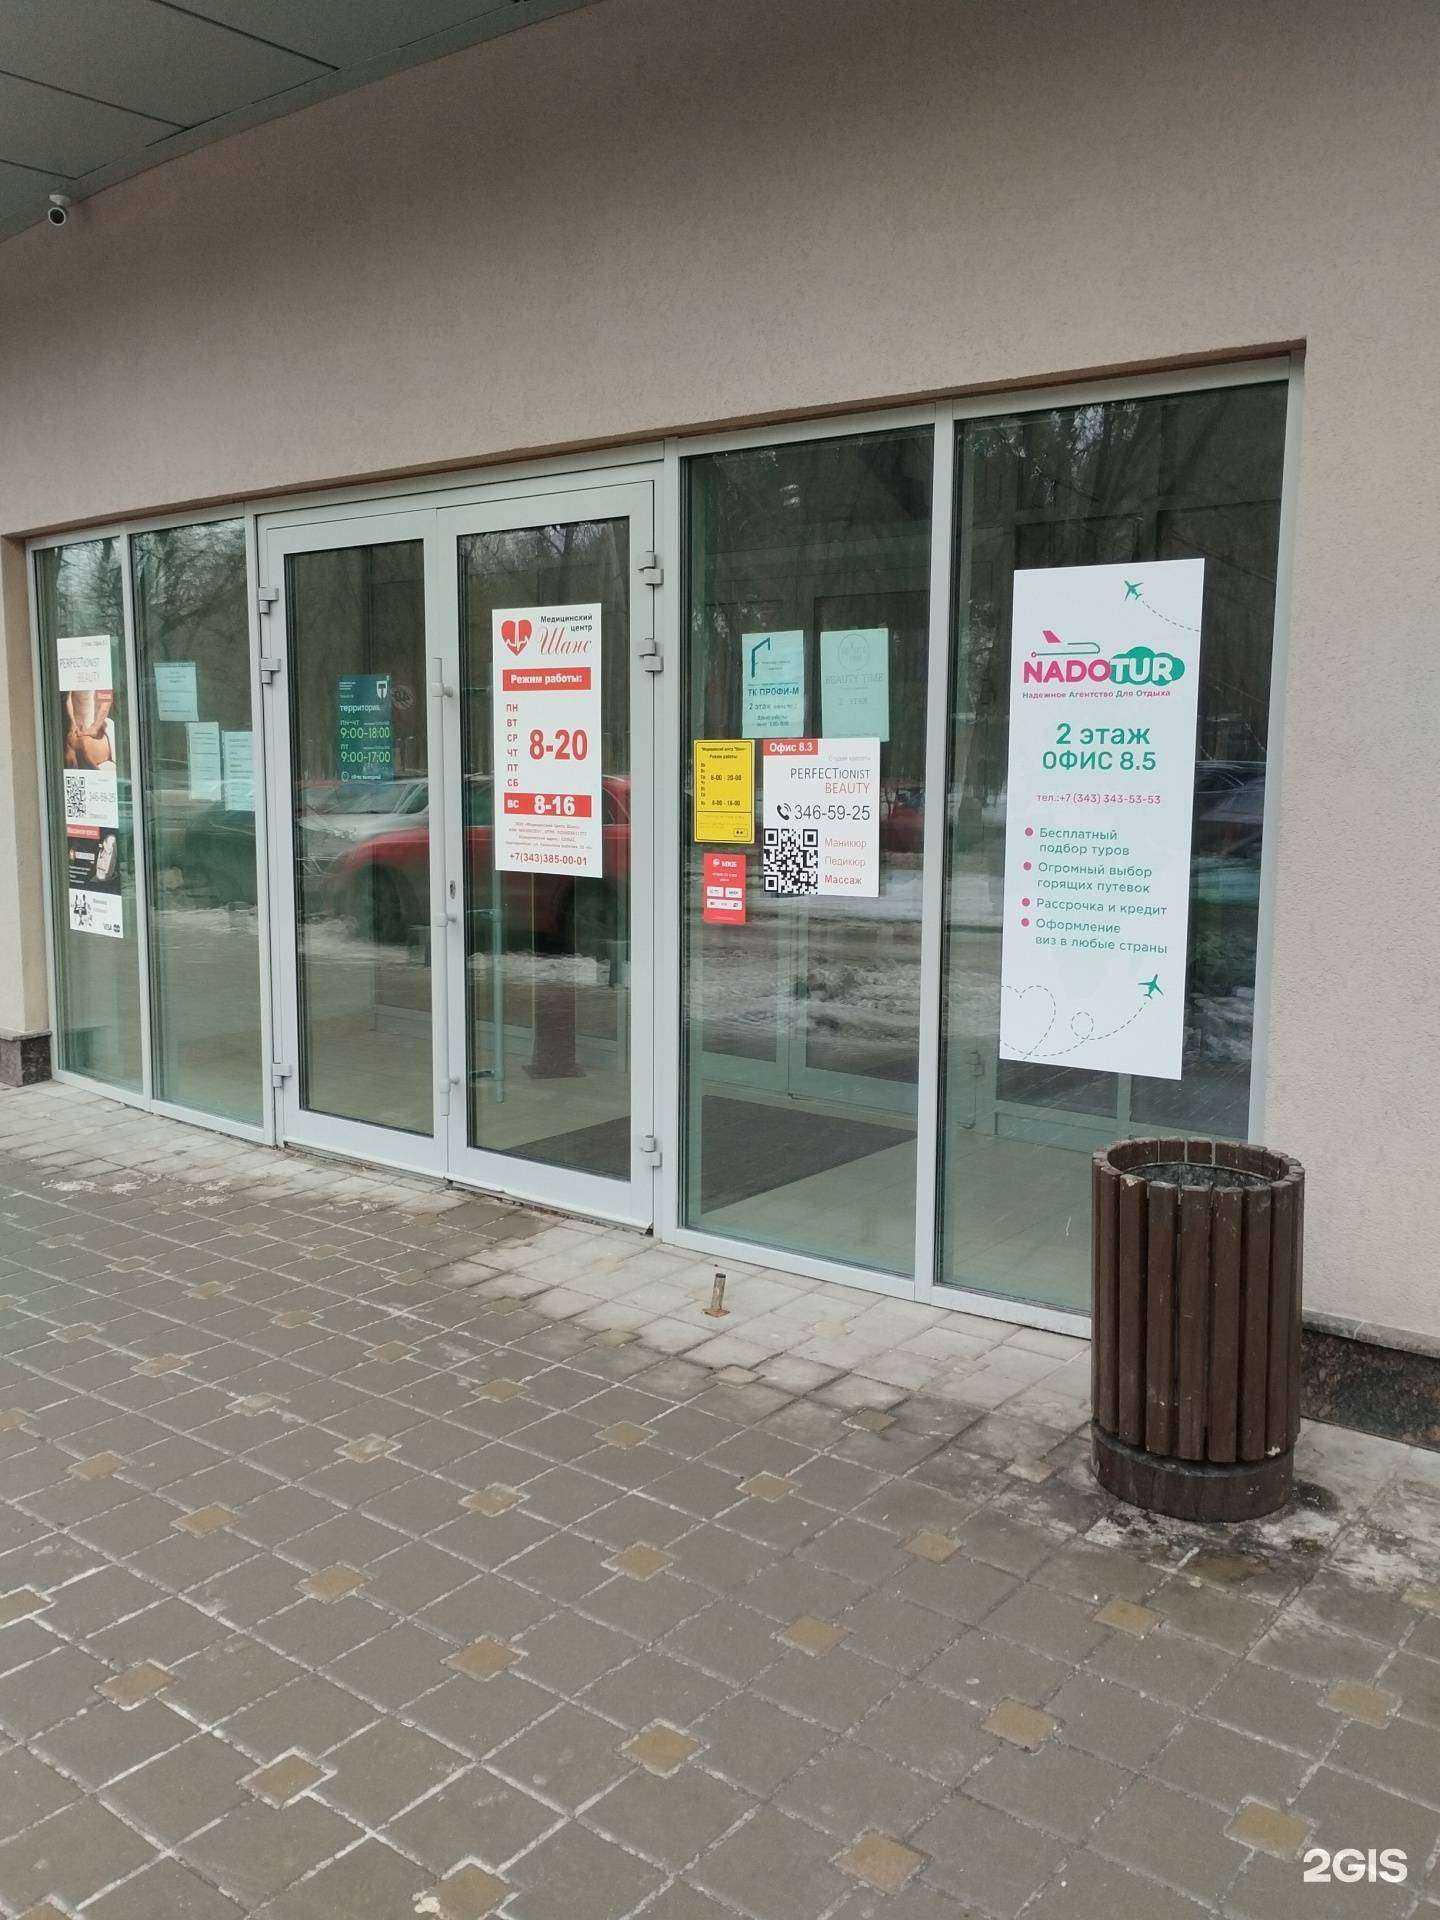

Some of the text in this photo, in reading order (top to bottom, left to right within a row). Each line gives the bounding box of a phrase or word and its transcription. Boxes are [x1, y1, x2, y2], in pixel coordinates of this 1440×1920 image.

[540, 614, 593, 624] Медицинский
[538, 627, 592, 656] Шанс
[1023, 657, 1173, 684] NADOTUR
[510, 674, 583, 686] Режим работы:
[759, 686, 800, 696] ПРОФИ-М
[1022, 689, 1171, 700] Надежное Агентство Для Отдыха
[506, 703, 519, 712] ПН
[506, 718, 518, 727] ВТ
[506, 733, 518, 742] СР
[1055, 722, 1151, 746] 2 этаж
[529, 729, 588, 760] 8-20
[769, 742, 813, 755] Офис 8.3
[506, 749, 519, 757] ЧТ
[1042, 749, 1157, 772] ОФИС 8.5
[506, 763, 519, 772] ПТ
[506, 778, 519, 787] СБ
[825, 782, 871, 794] BEAUTY
[506, 794, 576, 816] ВС 8-16
[1103, 793, 1162, 806] 343-53-53
[794, 804, 871, 821] 346-59-25
[1039, 827, 1118, 841] Бесплатный
[824, 837, 867, 849] Маникюр
[1039, 841, 1130, 857] подбор туров
[510, 852, 588, 866] +7(343)385-00-01
[824, 855, 866, 868] Педикюр
[1038, 862, 1152, 878] Огромный выбор
[824, 874, 862, 885] Массаж
[1037, 879, 1151, 895] горящих путевок
[1036, 898, 1167, 917] Рассрочка и кредит
[1035, 918, 1121, 934] Оформление
[1035, 936, 1168, 955] виз в любые страны
